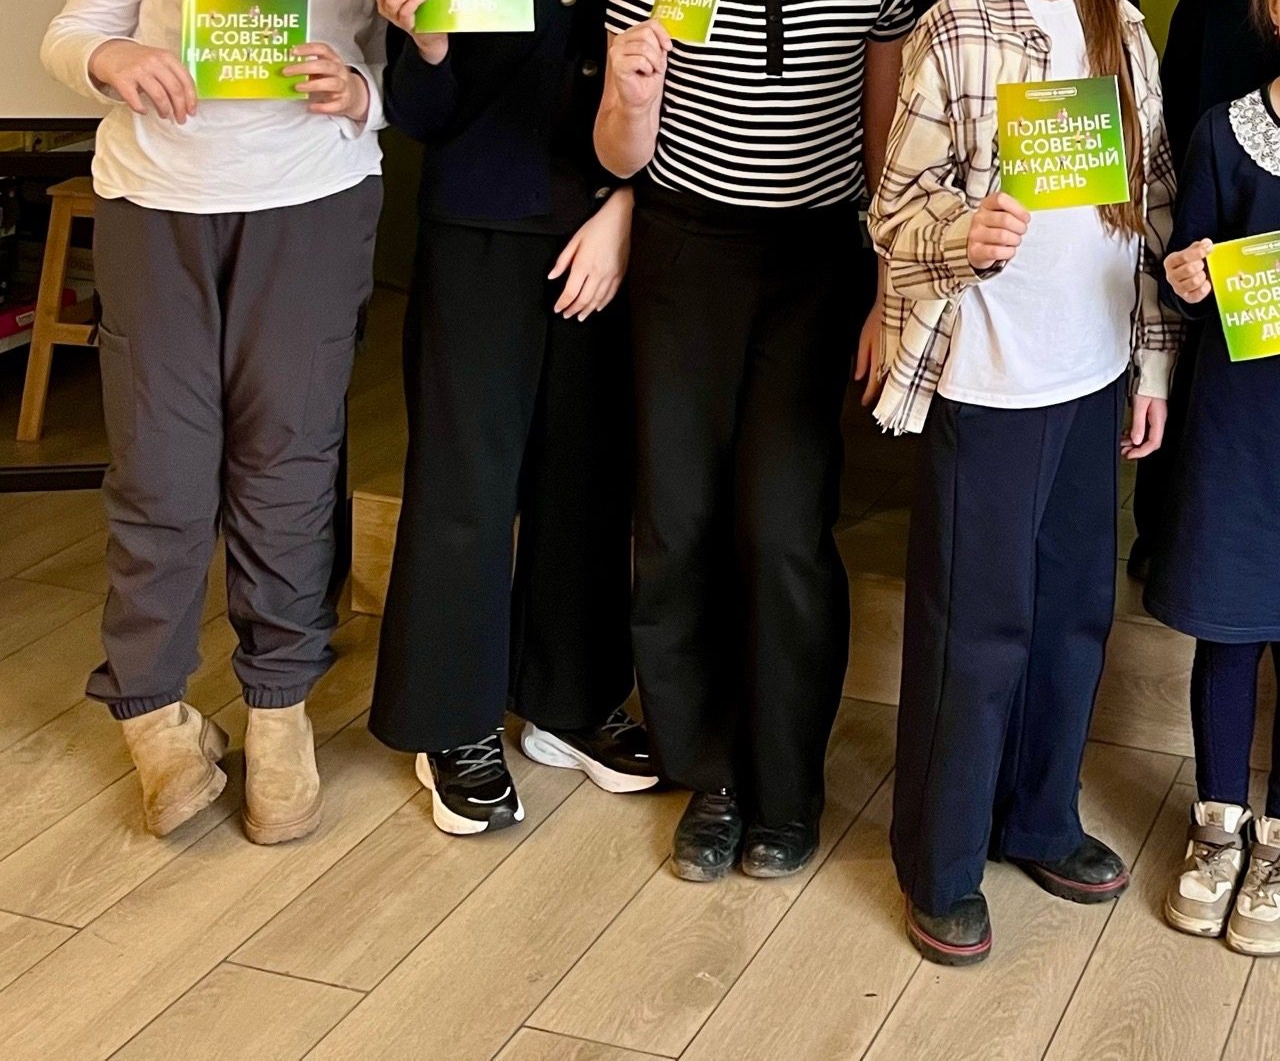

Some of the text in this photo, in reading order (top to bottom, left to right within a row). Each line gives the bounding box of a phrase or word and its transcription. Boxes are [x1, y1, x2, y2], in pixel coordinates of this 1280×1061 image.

[196, 14, 299, 28] ПОЛЕЗНЫЕ
[210, 30, 288, 45] СОВЕТЫ
[218, 65, 270, 82] ДЕНЬ
[1007, 114, 1112, 137] ПОЛЕЗНЫЕ
[1020, 134, 1102, 155] СОВЕТЫ
[1003, 147, 1119, 176] НА КАЖДЫЙ
[1034, 172, 1087, 194] ДЕНЬ
[1226, 310, 1253, 327] НА
